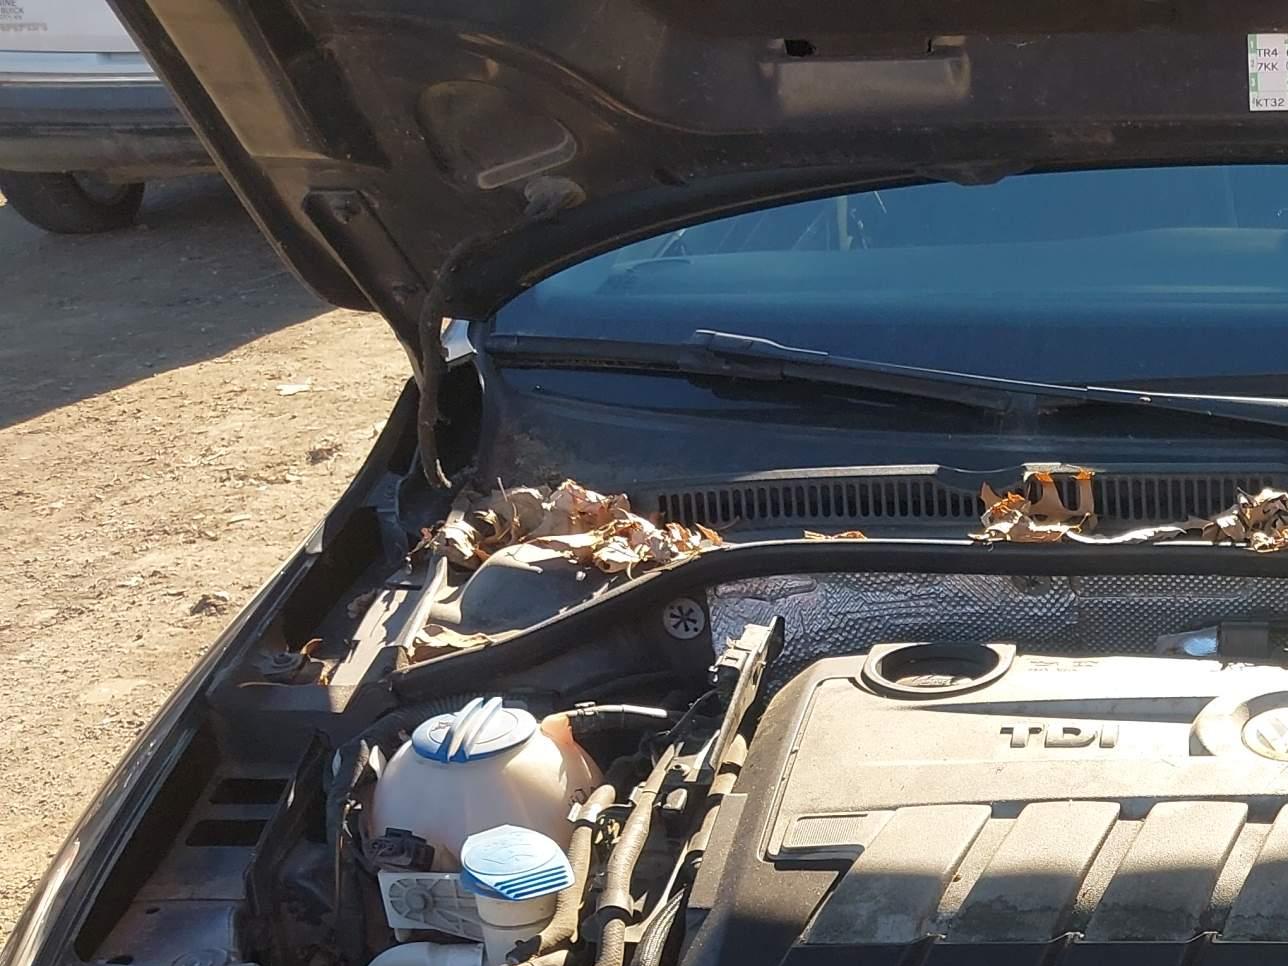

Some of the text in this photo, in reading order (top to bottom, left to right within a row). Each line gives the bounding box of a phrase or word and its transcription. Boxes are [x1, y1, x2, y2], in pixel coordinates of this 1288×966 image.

[1256, 48, 1278, 57] TR4
[1257, 62, 1279, 71] 7KK
[1000, 723, 1119, 749] TDI
